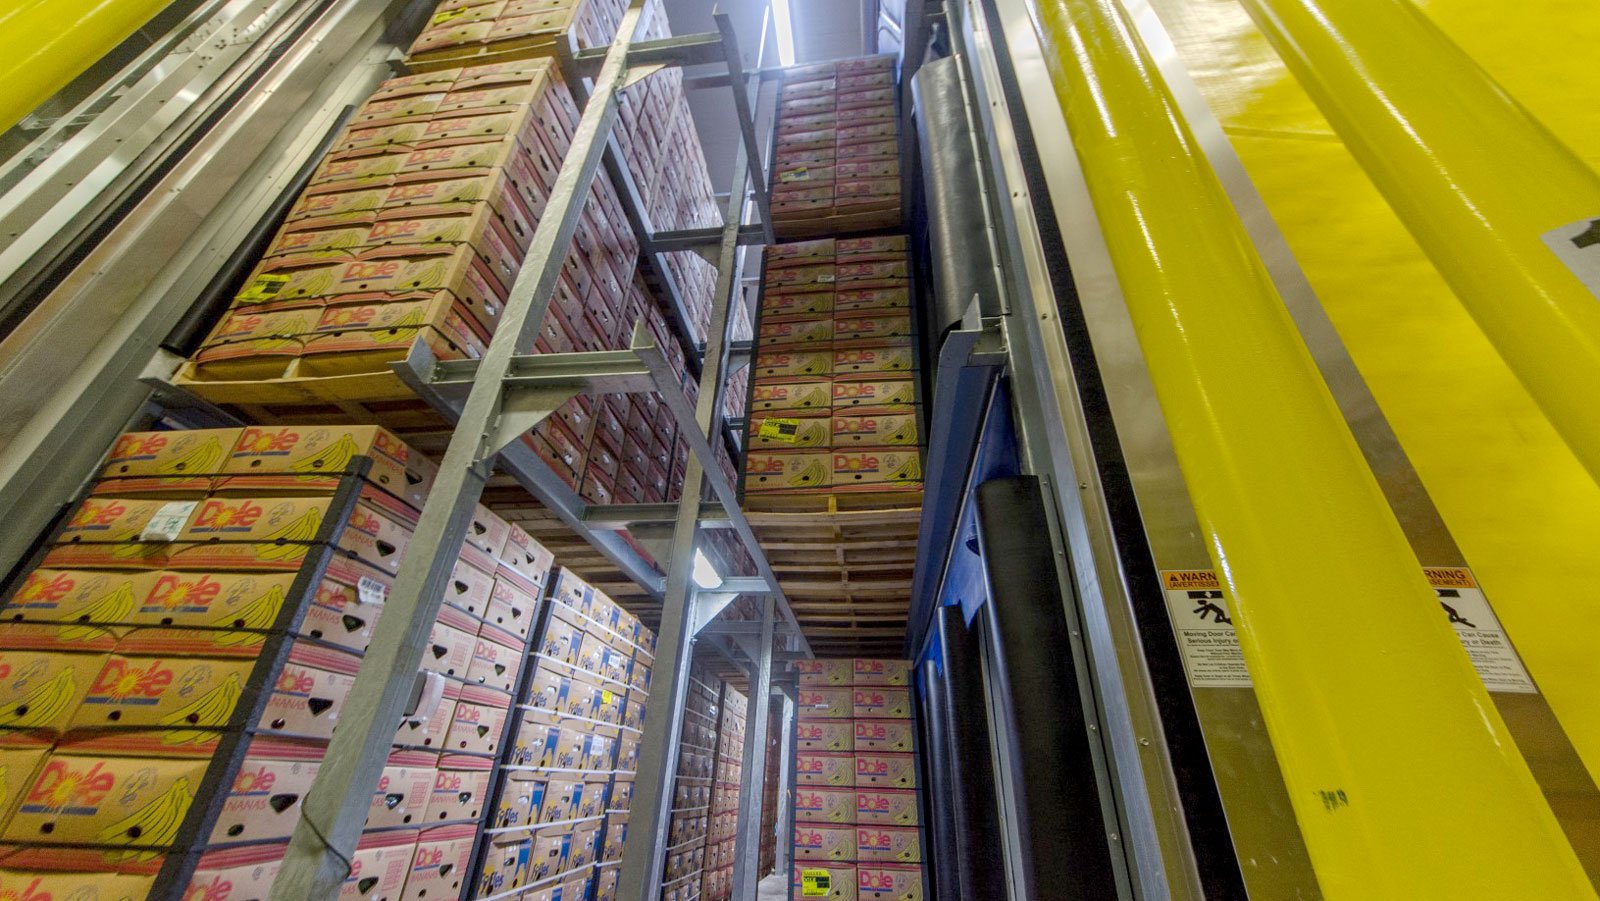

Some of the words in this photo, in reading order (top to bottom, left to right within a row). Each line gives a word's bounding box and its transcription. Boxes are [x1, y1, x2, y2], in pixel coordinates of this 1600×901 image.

[425, 119, 472, 134] Dole
[406, 149, 455, 165] Dole
[387, 183, 438, 201] Dole
[368, 221, 420, 240] Dole
[344, 263, 399, 279] Dole
[837, 264, 873, 276] Dole
[836, 291, 874, 302] Dole
[318, 306, 376, 326] Dole
[835, 319, 874, 331] Dole
[758, 353, 790, 366] Dole
[834, 349, 875, 362] Dole
[752, 387, 787, 398] Dole
[834, 383, 875, 397] Dole
[834, 418, 877, 432] Dole
[109, 433, 168, 459] Dole
[236, 428, 299, 452] Dole
[374, 431, 409, 463] Dole
[746, 457, 784, 471] Dole
[834, 454, 879, 470] Dole
[193, 501, 262, 528] Dole
[511, 525, 529, 549] Dole
[1179, 572, 1217, 580] WARN
[144, 575, 221, 608] Dole
[495, 583, 514, 604] Dole
[477, 641, 498, 659] Dole
[795, 660, 822, 672] Dole
[855, 659, 883, 672] Dole
[90, 659, 174, 698] Dole
[855, 692, 884, 704] Dole
[457, 704, 480, 722] Dole
[856, 724, 885, 737] Dole
[857, 758, 888, 773] Dole
[29, 760, 115, 808] Dole
[436, 772, 461, 790] Dole
[858, 794, 890, 810] Dole
[859, 831, 891, 847] Dole
[416, 847, 443, 866] Dole
[860, 871, 893, 889] Dole
